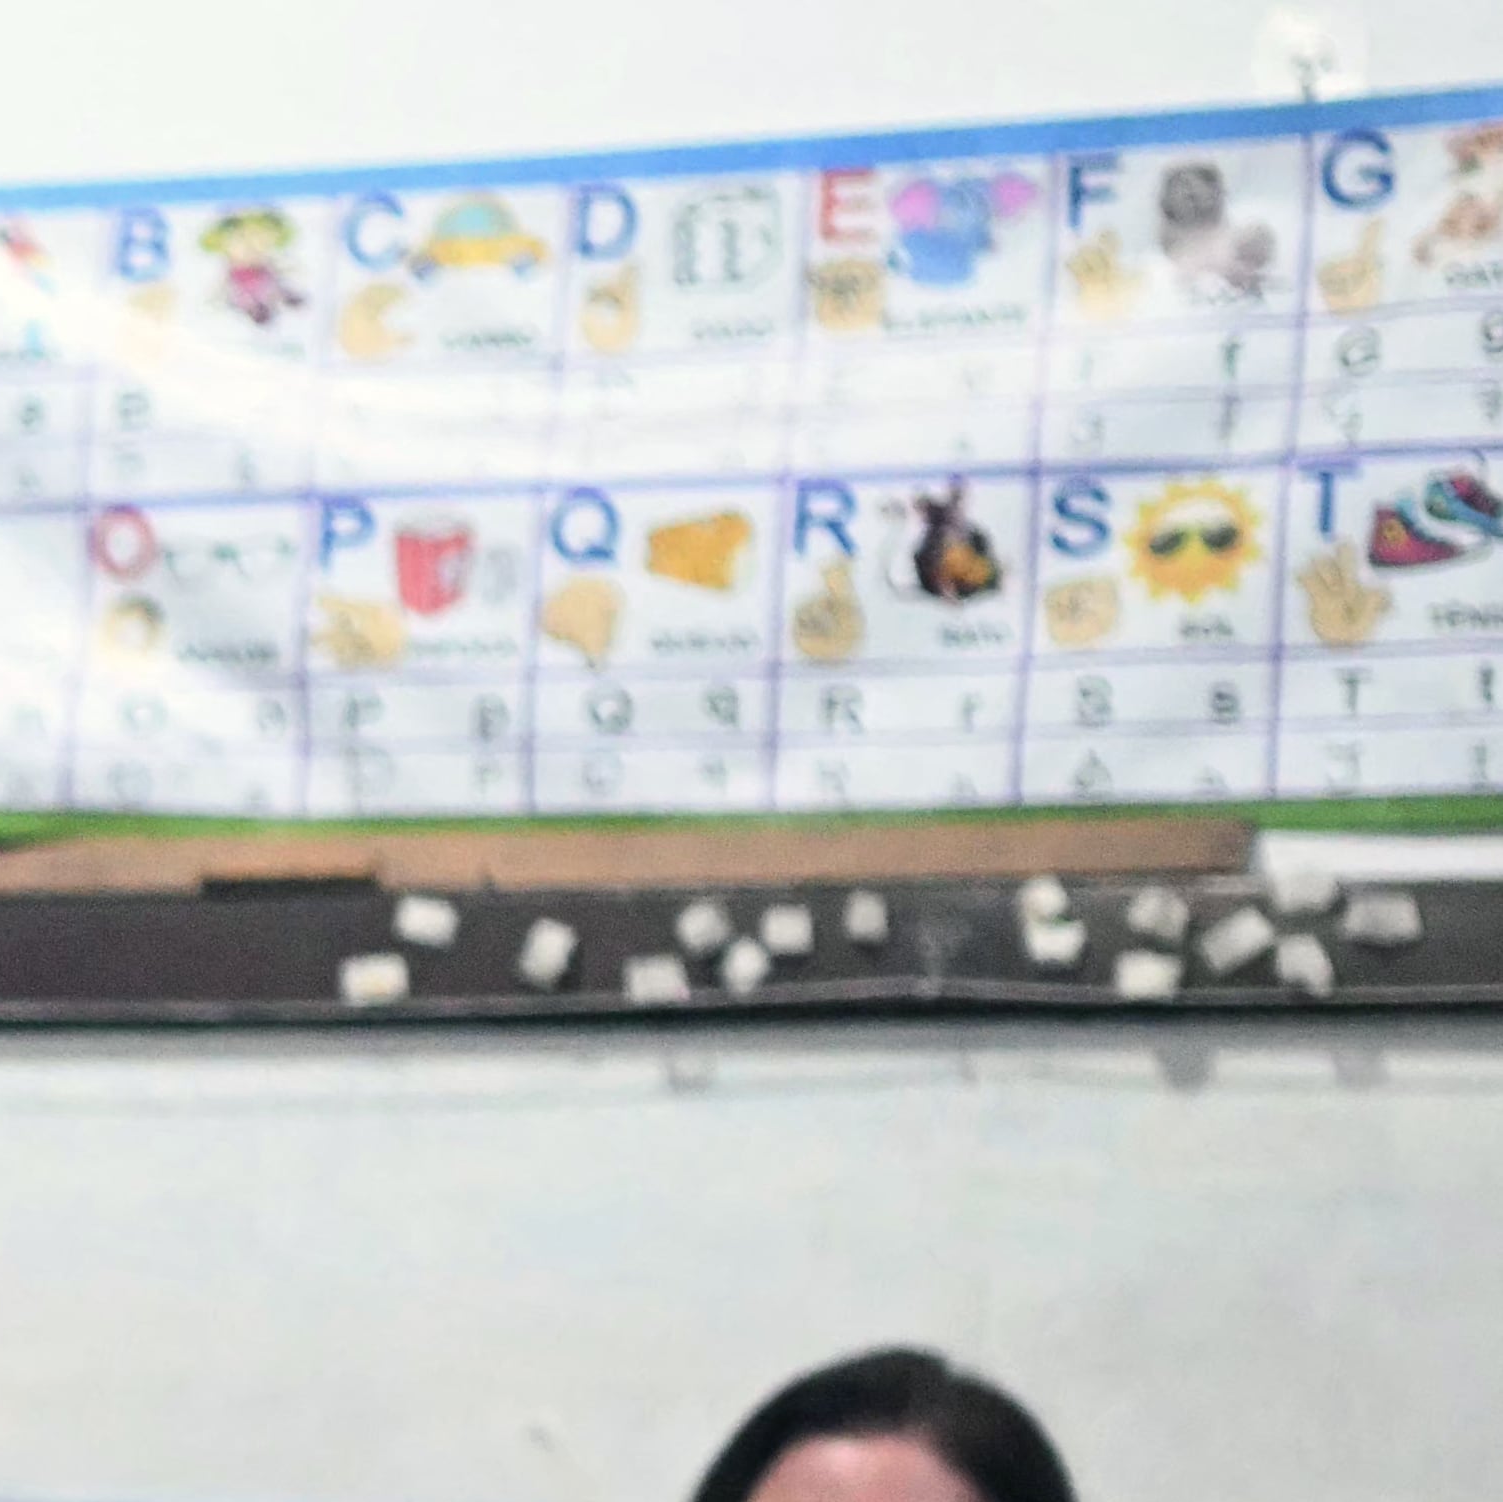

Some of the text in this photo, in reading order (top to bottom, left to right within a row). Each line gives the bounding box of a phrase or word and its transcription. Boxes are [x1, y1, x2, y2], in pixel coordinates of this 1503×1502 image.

[819, 166, 877, 246] E
[1067, 151, 1120, 230] F
[1321, 127, 1394, 209] G
[114, 205, 171, 283] B
[343, 189, 405, 271] C
[570, 180, 638, 261] D
[318, 494, 375, 569] P
[549, 486, 621, 566] Q
[794, 478, 859, 557] R
[1050, 476, 1114, 558] S
[1296, 460, 1362, 540] T
[89, 505, 158, 581] O
[1332, 665, 1375, 717] T
